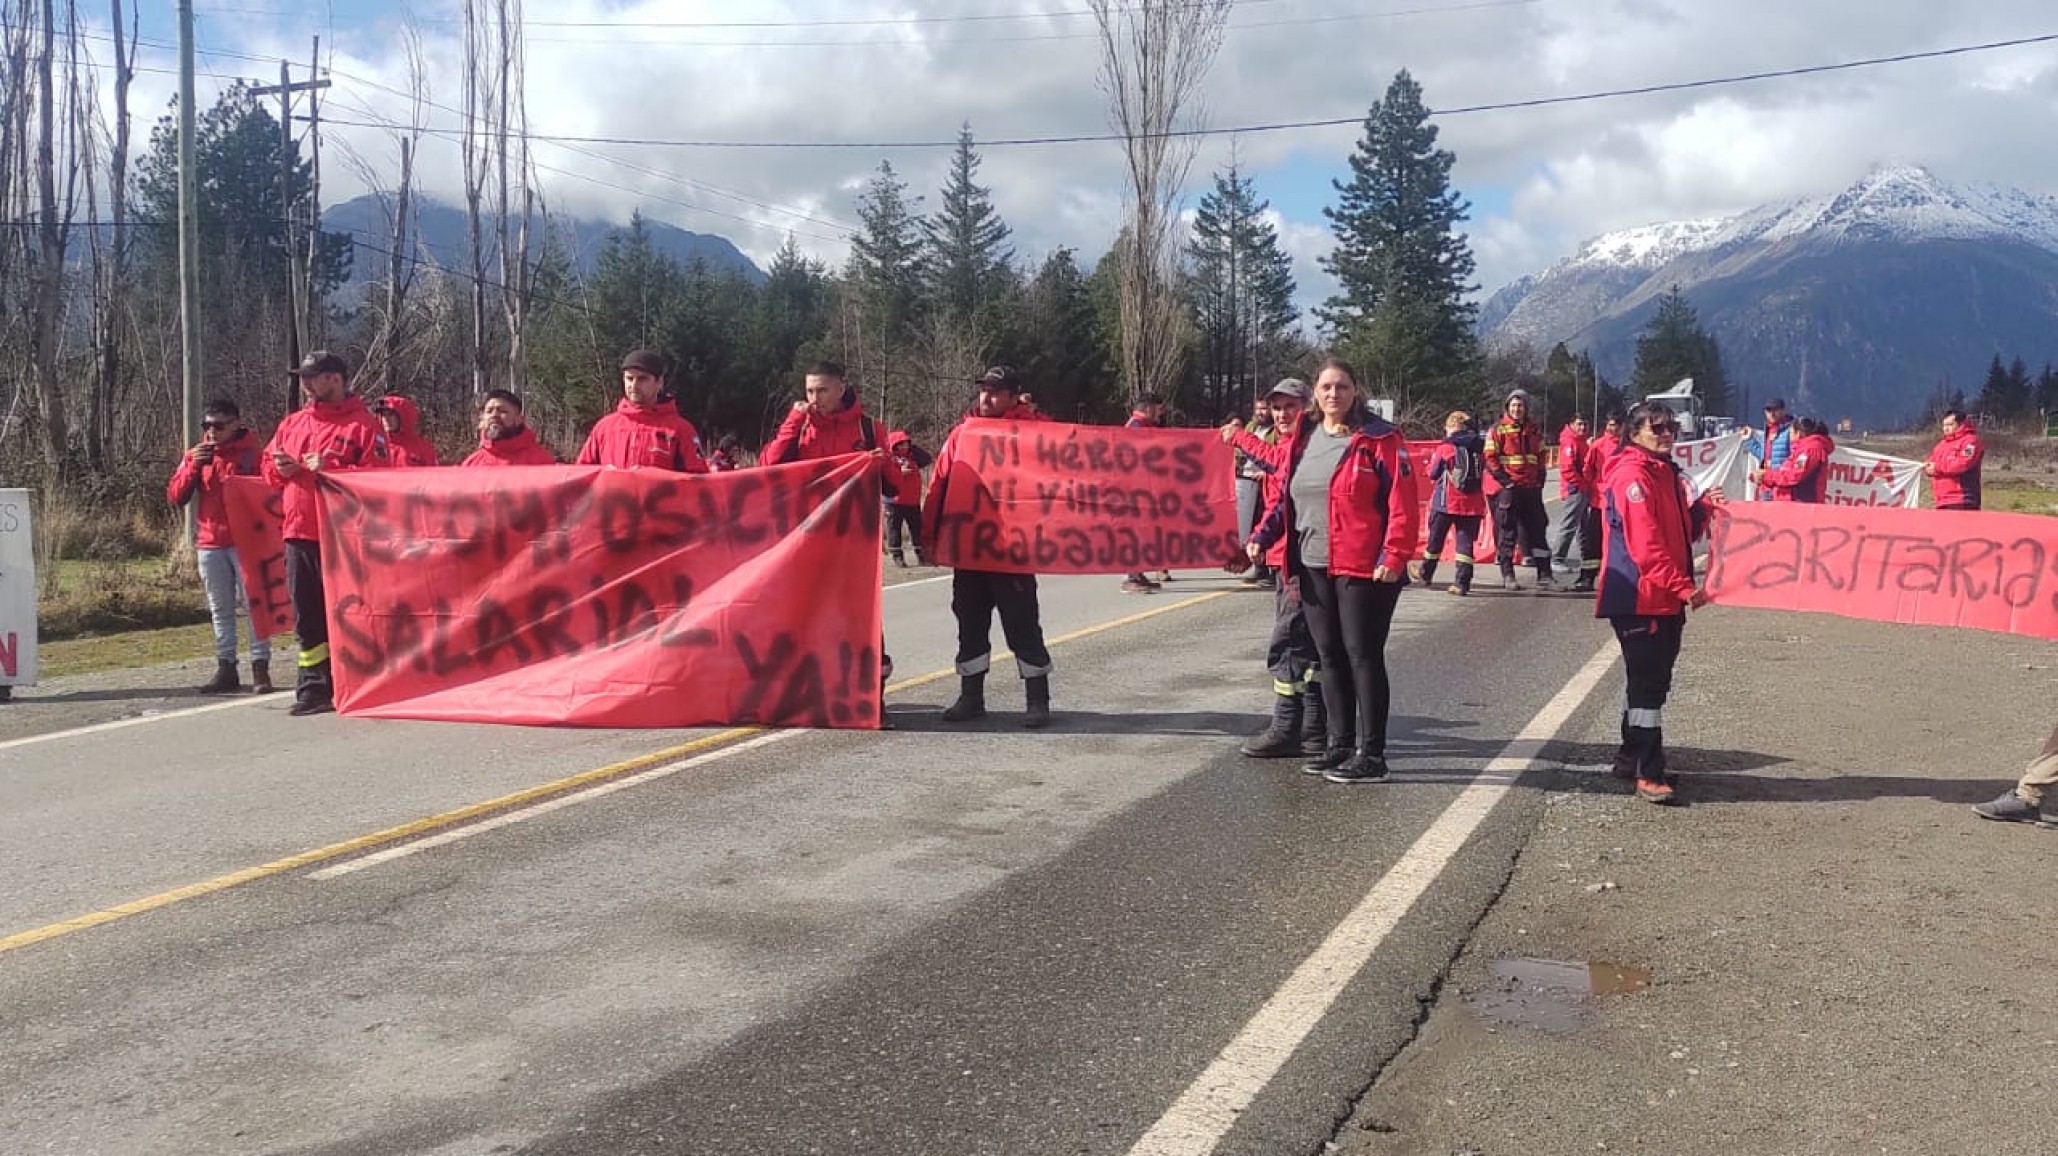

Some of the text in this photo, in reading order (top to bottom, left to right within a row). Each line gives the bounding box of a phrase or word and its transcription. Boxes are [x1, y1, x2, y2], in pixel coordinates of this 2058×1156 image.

[978, 425, 1020, 473] Ni
[973, 477, 1017, 513] Ni
[1712, 514, 2058, 613] PaRiTaRia
[733, 631, 878, 728] YA!!
